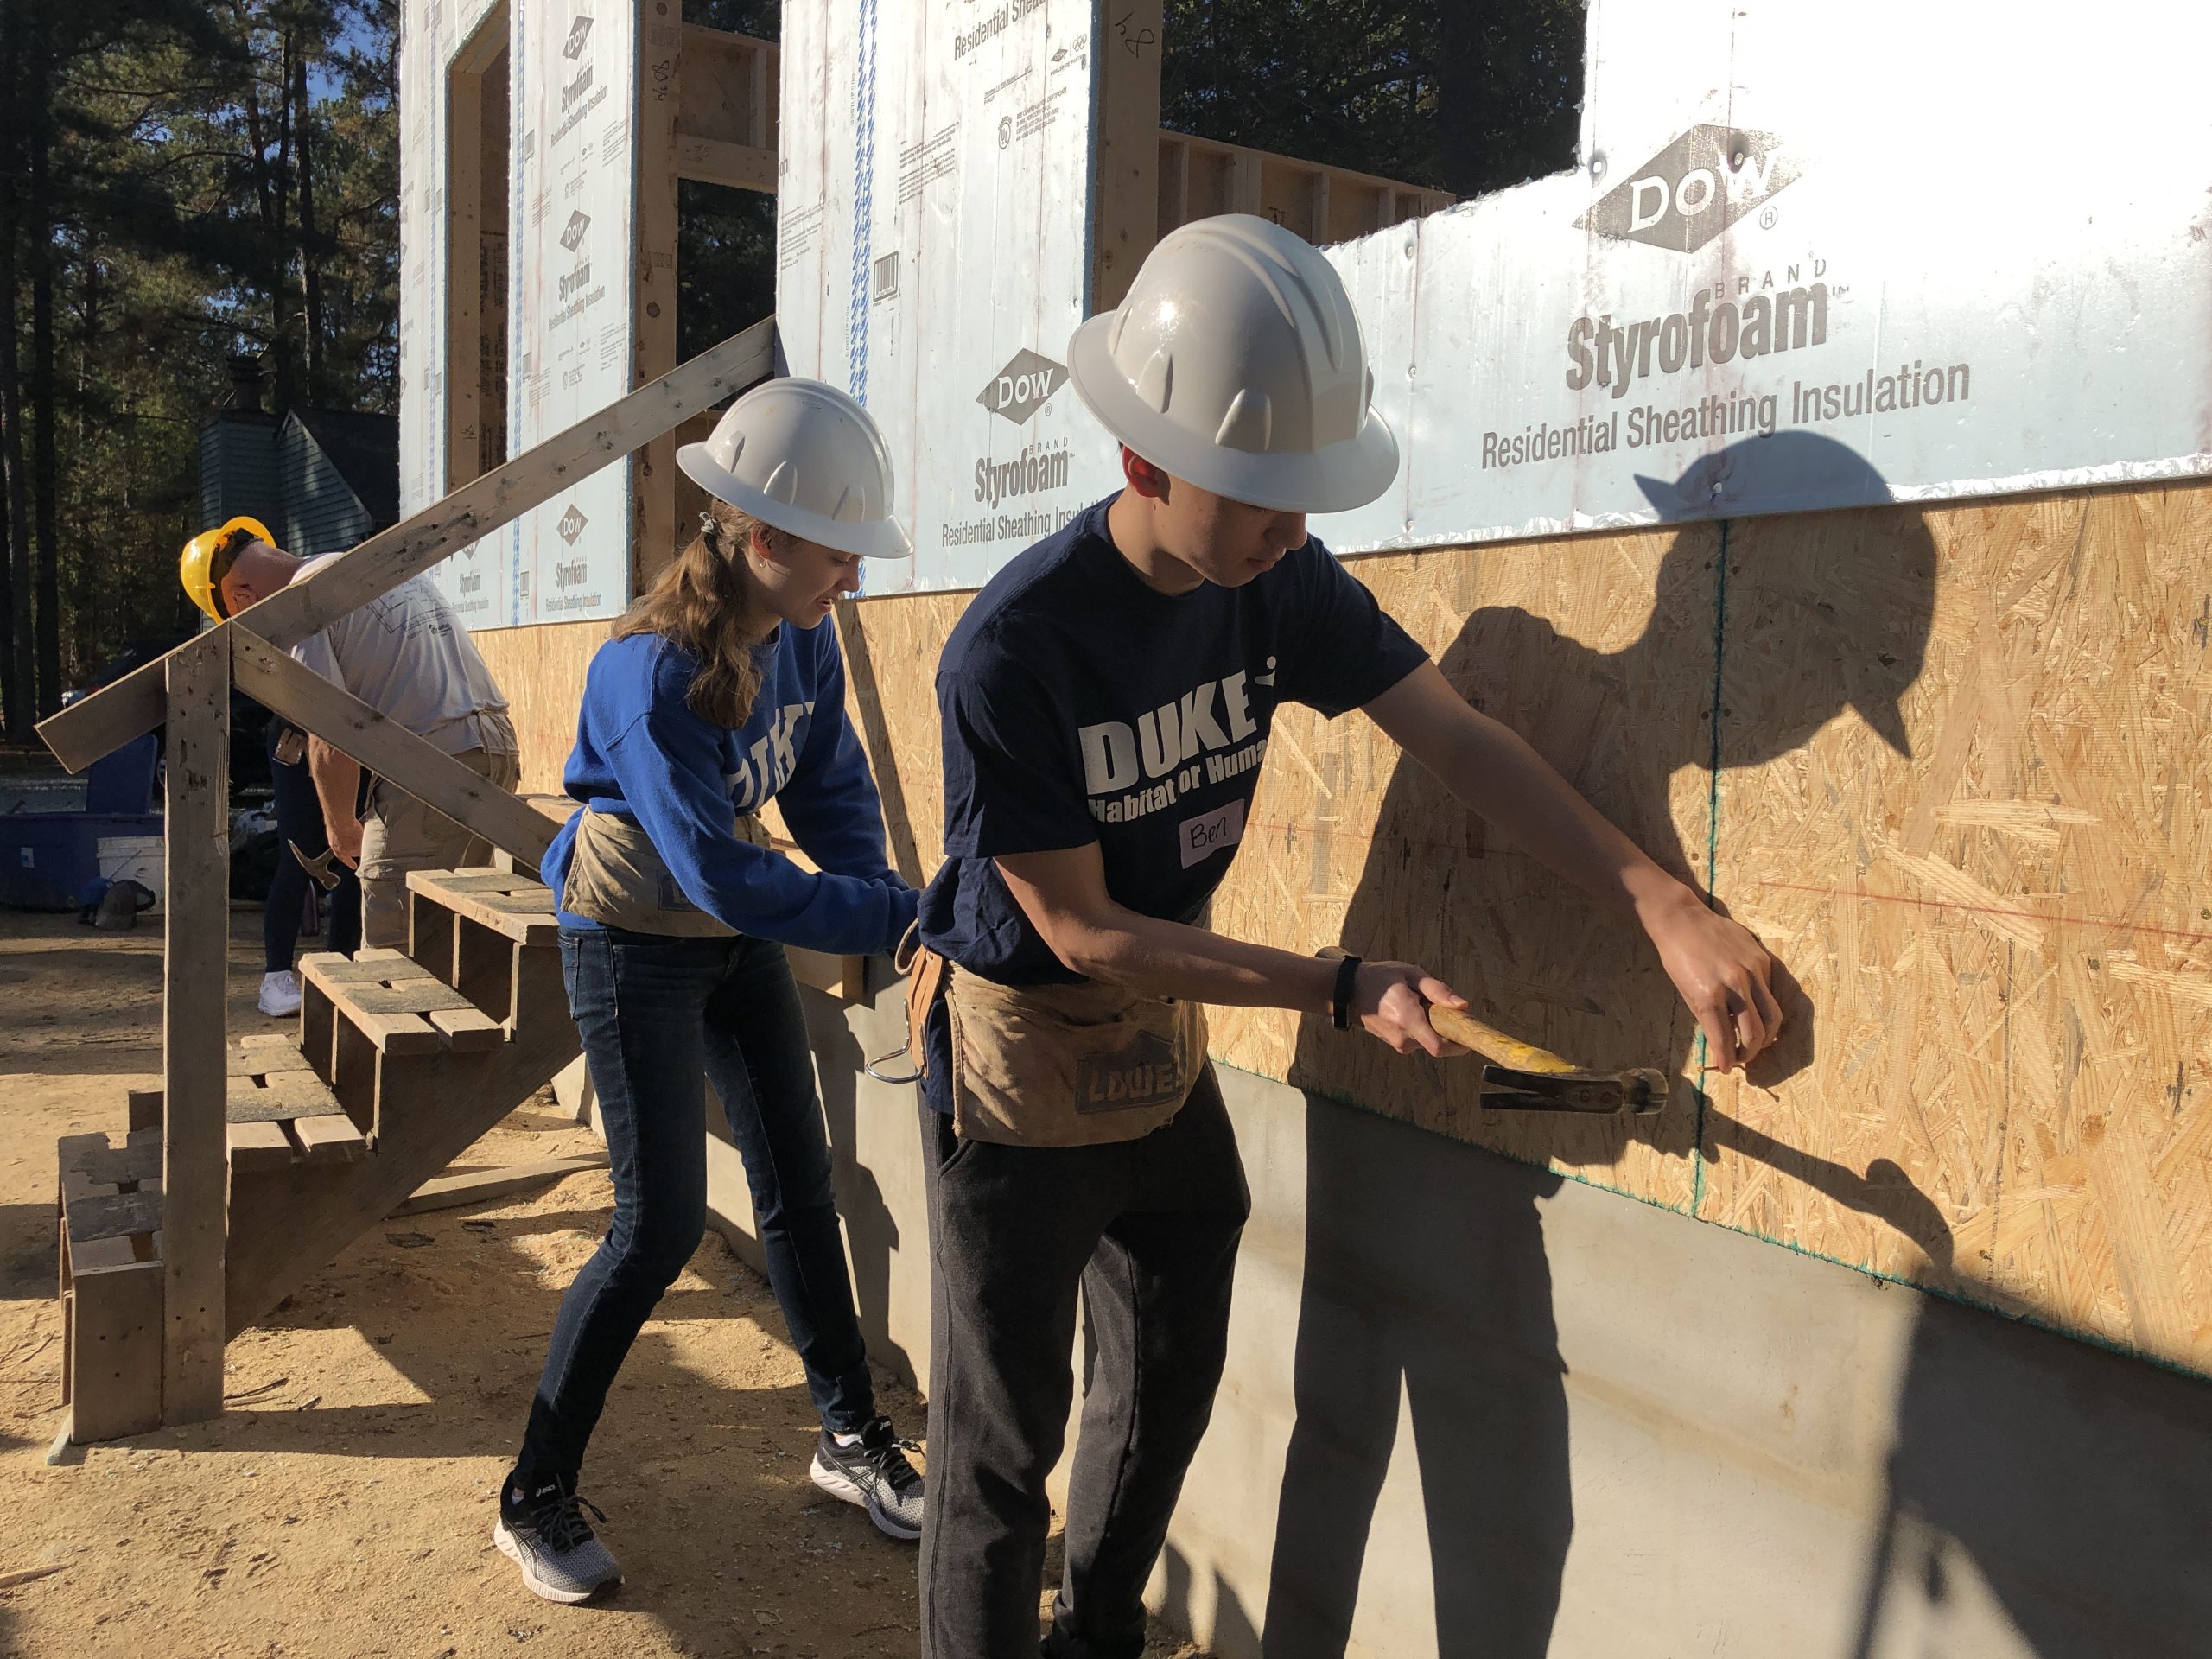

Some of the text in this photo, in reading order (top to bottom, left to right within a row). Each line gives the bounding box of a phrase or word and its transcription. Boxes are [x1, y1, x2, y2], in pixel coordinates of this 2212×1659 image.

[567, 22, 588, 55] DOW
[954, 3, 1009, 61] Residential
[562, 64, 593, 114] Styrofoam
[1628, 150, 1778, 233] DOW
[566, 218, 586, 246] DOW
[558, 262, 590, 303] Styrofoam
[1715, 258, 1827, 299] BRAND
[1565, 282, 1828, 399] Styrofoam
[997, 368, 1054, 410] DOW
[1482, 362, 1970, 469] Residential Sheathing Insulation
[1028, 436, 1069, 454] BRAND
[975, 448, 1069, 510] Styrofoam
[563, 516, 582, 536] DOW
[942, 517, 995, 547] Residential
[998, 509, 1052, 540] Sheathing
[556, 559, 588, 592] Styrofoam
[1077, 668, 1257, 796] DUKE
[1087, 779, 1178, 823] Habitat
[1178, 765, 1202, 798] or
[1189, 816, 1227, 849] Ben
